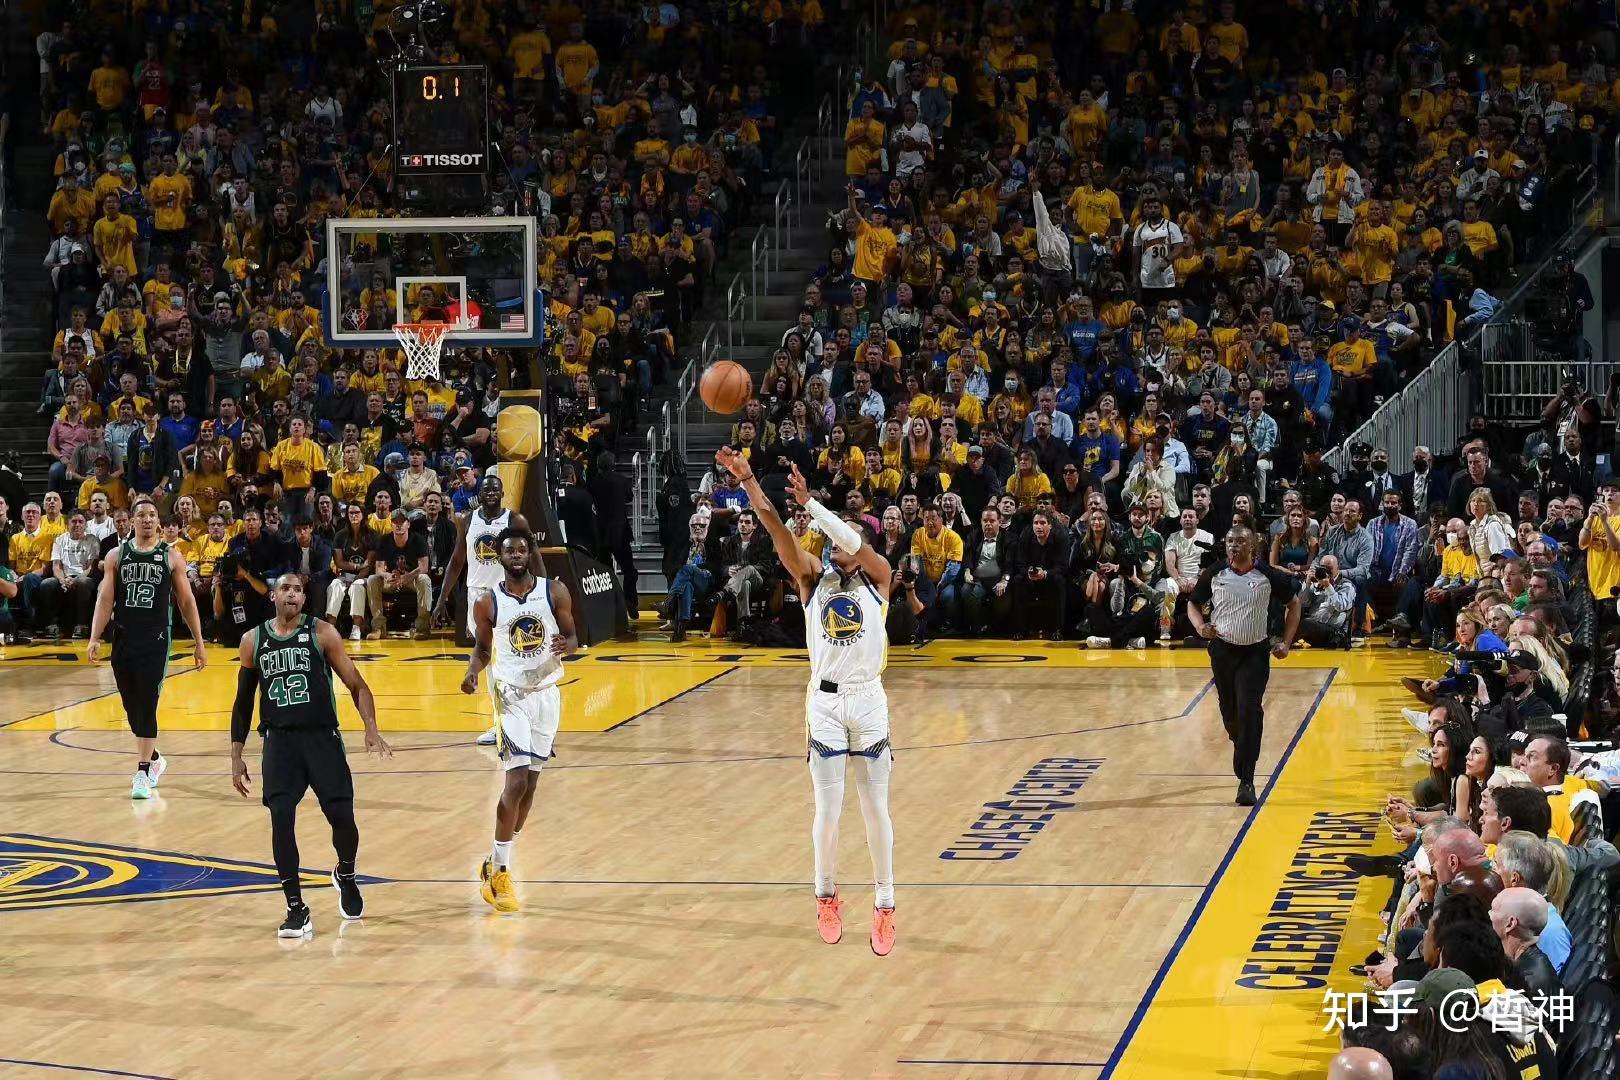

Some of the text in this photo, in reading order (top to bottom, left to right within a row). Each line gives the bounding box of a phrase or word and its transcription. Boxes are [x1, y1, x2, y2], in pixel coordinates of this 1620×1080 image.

[423, 153, 483, 166] TISSOT
[1151, 246, 1166, 258] 30
[121, 562, 163, 584] CELTICS
[582, 568, 612, 596] coinbase
[125, 583, 155, 608] 12
[846, 605, 855, 617] 3
[527, 622, 541, 635] 22
[822, 629, 865, 647] WARRIORS
[510, 641, 548, 660] WARRIORS
[260, 647, 311, 679] CELTICS
[268, 673, 310, 707] 42
[939, 757, 1107, 860] CHASE CENTER
[1235, 869, 1361, 990] CELEBRATING
[1298, 811, 1383, 850] YEARS
